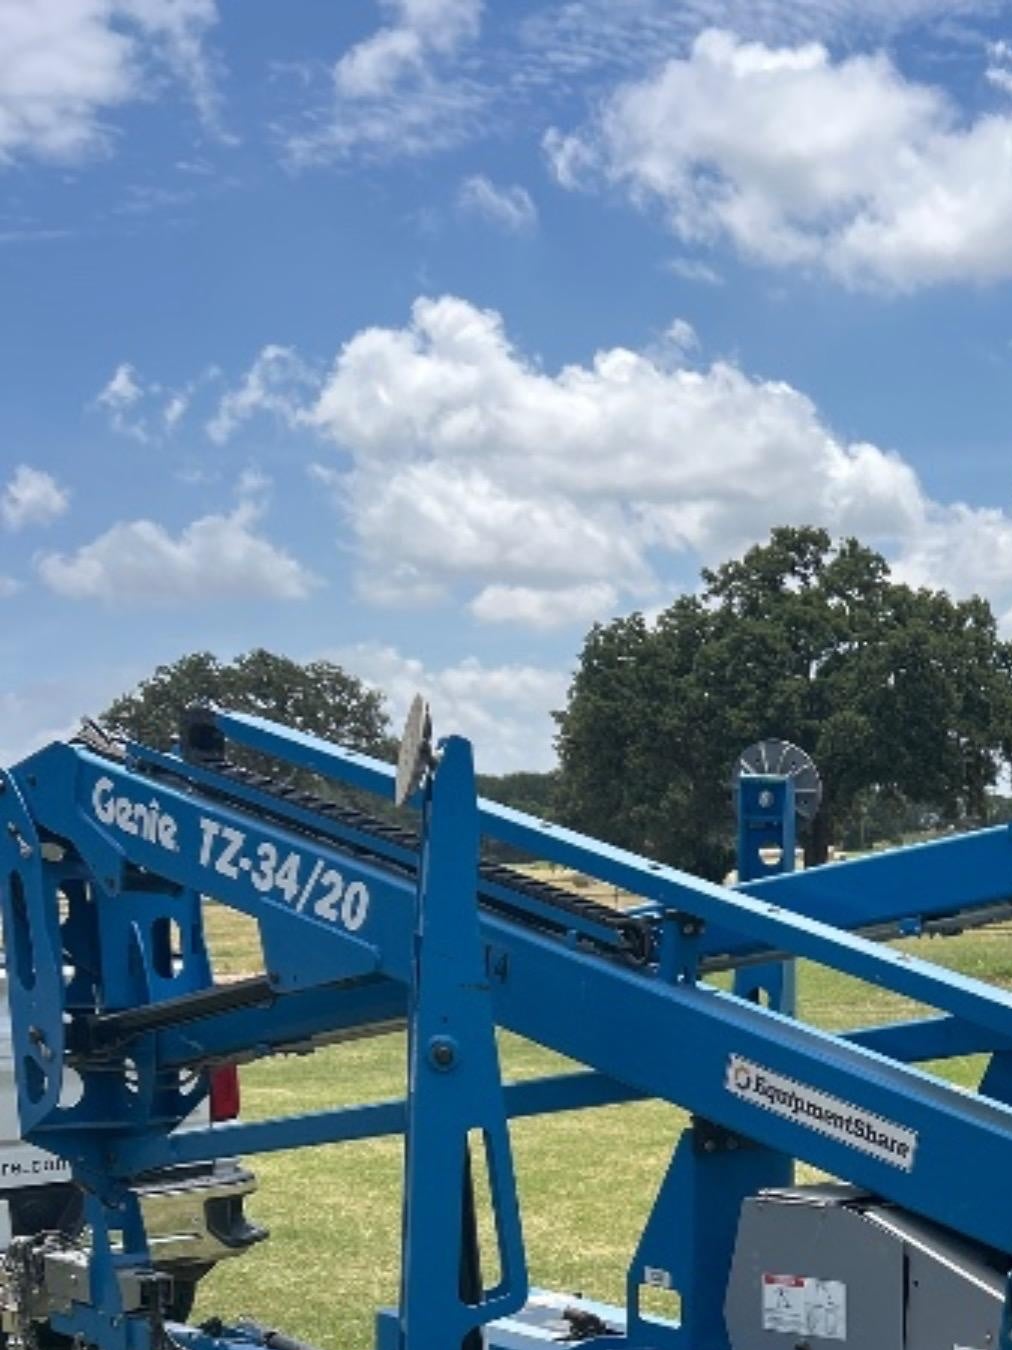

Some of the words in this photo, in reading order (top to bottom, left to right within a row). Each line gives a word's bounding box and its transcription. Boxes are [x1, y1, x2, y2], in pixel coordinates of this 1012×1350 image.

[92, 776, 180, 852] Genie
[200, 816, 370, 932] TZ-34/20
[752, 1074, 910, 1159] EquipmentShare
